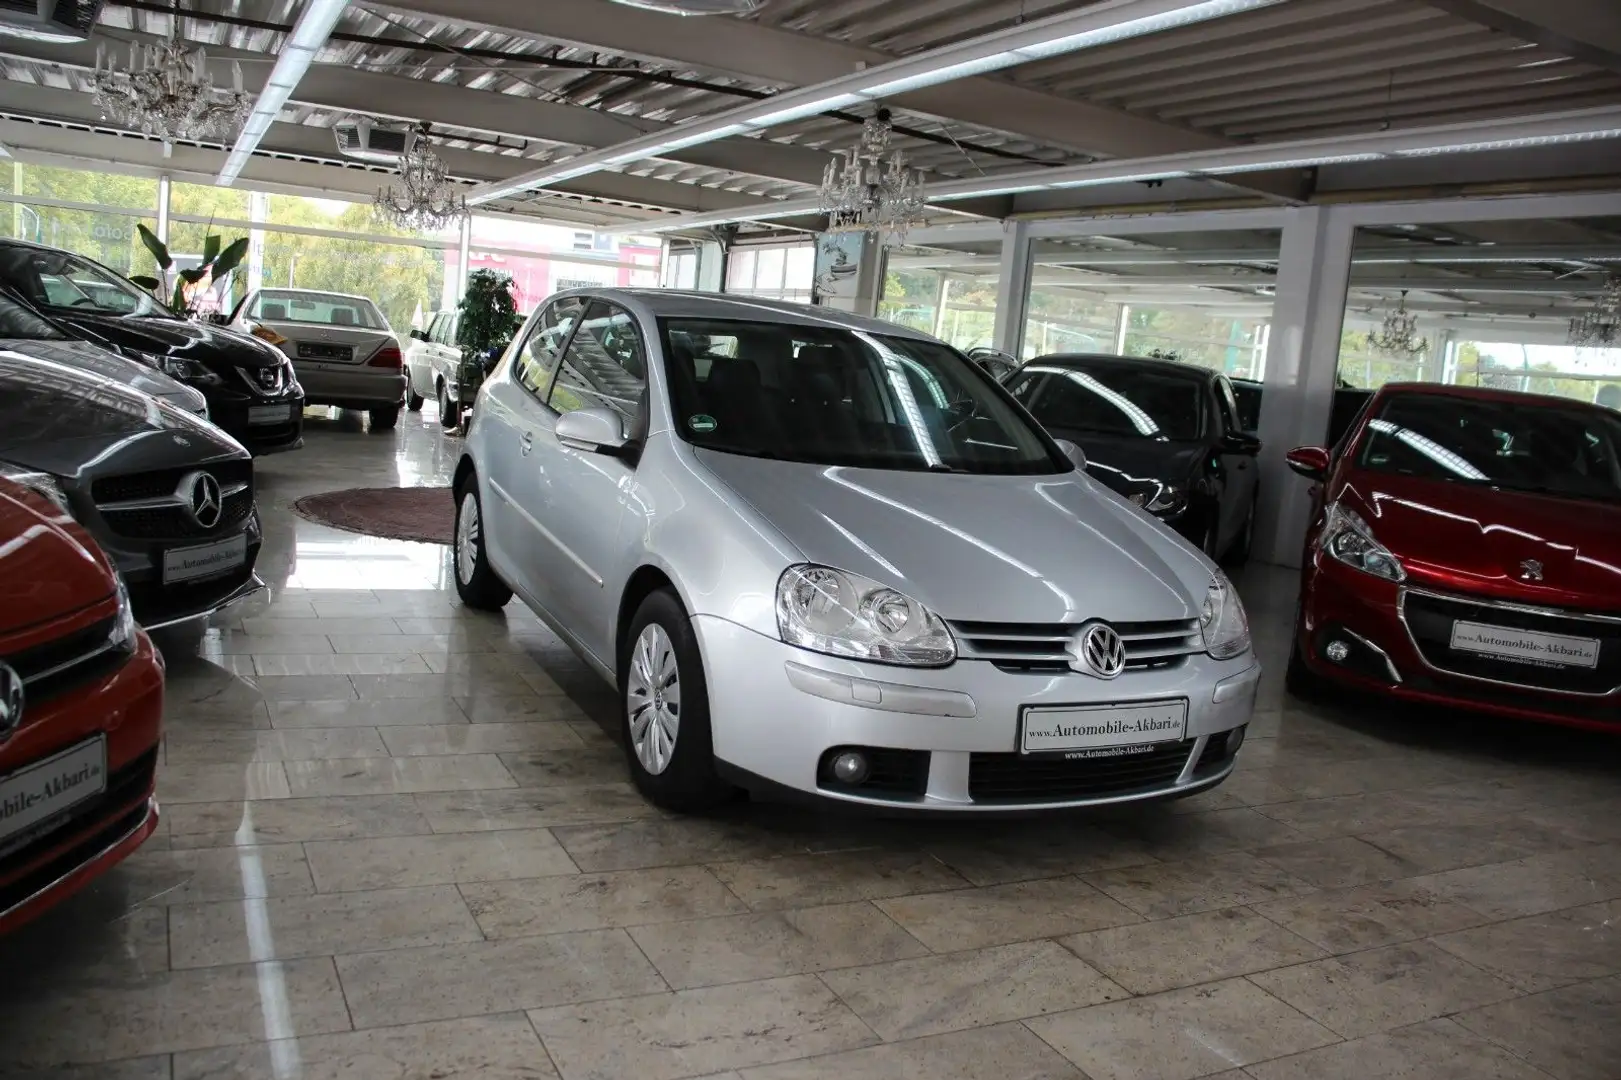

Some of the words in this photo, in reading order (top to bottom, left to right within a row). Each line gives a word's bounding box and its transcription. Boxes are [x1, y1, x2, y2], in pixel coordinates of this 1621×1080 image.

[1087, 628, 1122, 673] VW
[1456, 633, 1593, 659] www.Automobile-Akbari.de
[1028, 716, 1181, 738] www.Automobile-Akbari.de
[1064, 745, 1155, 760] www.Automobile-Akbari.de
